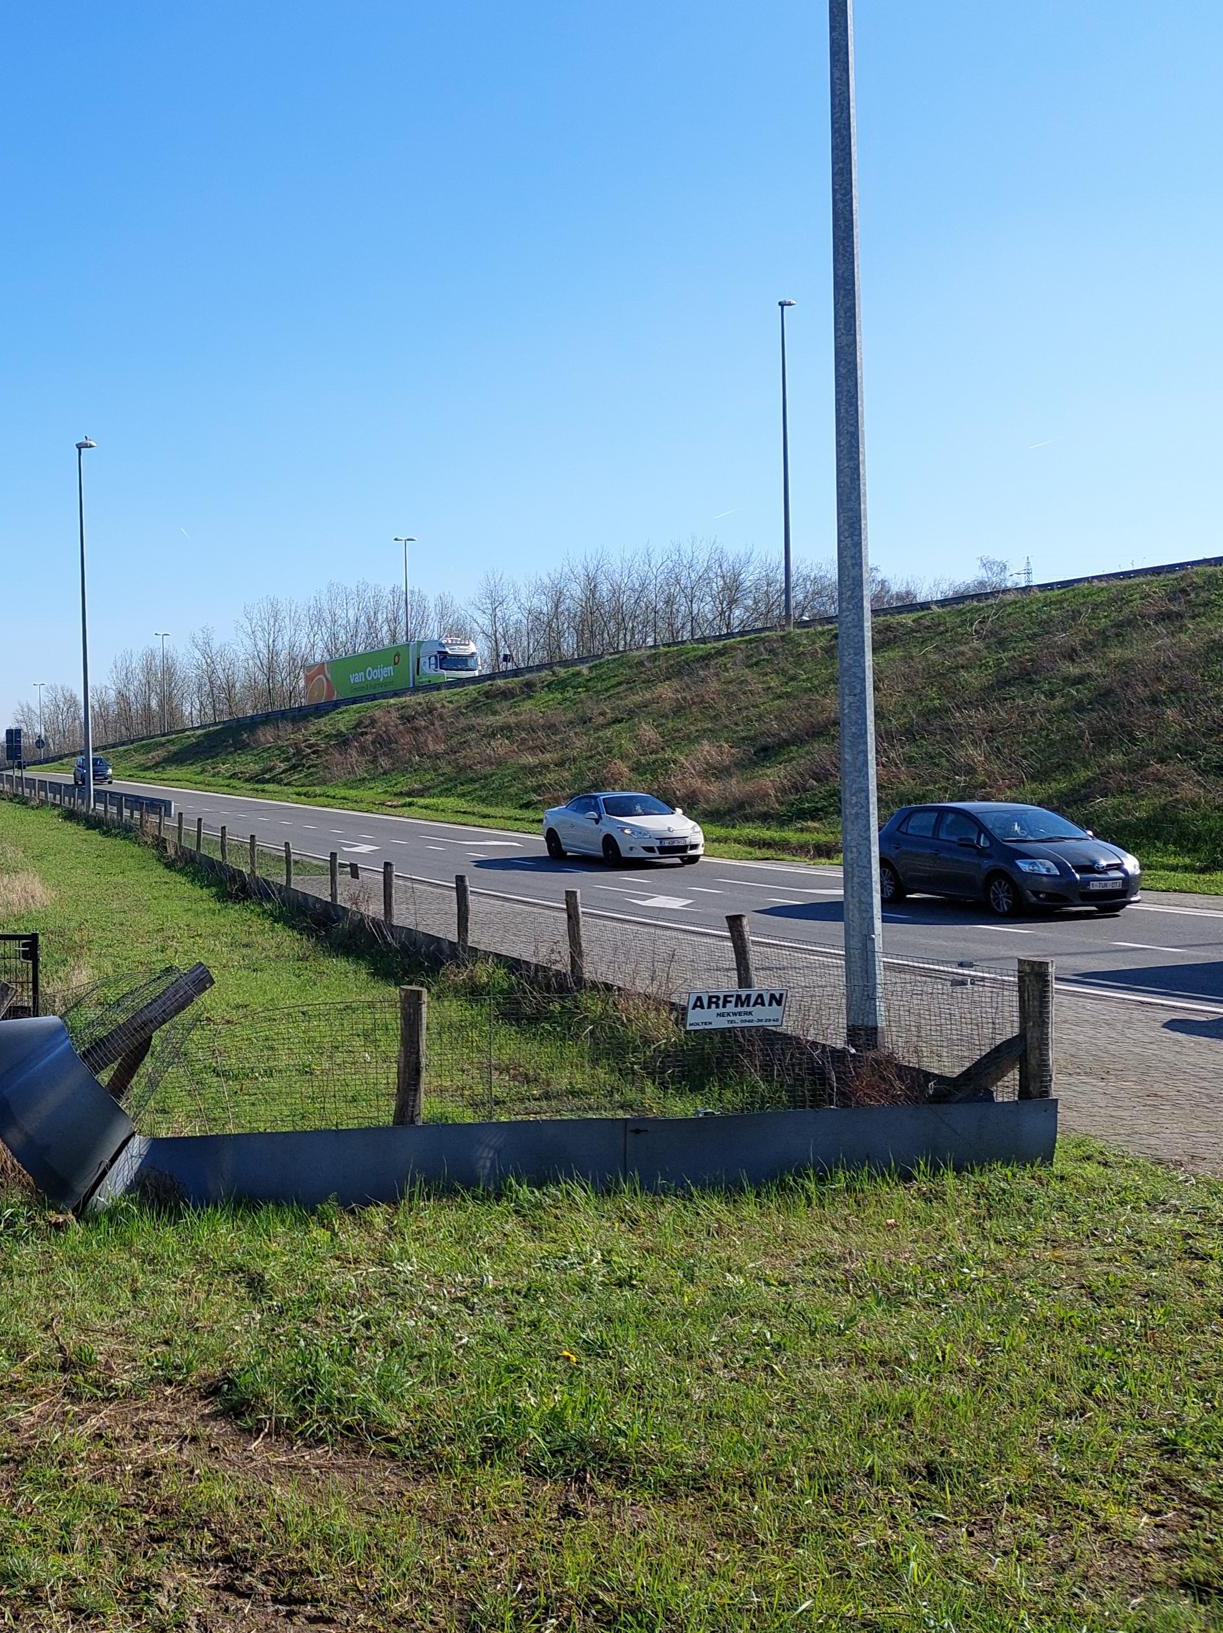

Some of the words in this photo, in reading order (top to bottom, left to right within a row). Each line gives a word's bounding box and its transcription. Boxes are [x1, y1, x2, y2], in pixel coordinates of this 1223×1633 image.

[349, 671, 365, 684] van
[366, 664, 394, 682] Ooijen
[691, 993, 784, 1010] ARFMAN
[716, 1010, 754, 1018] HEKWERK
